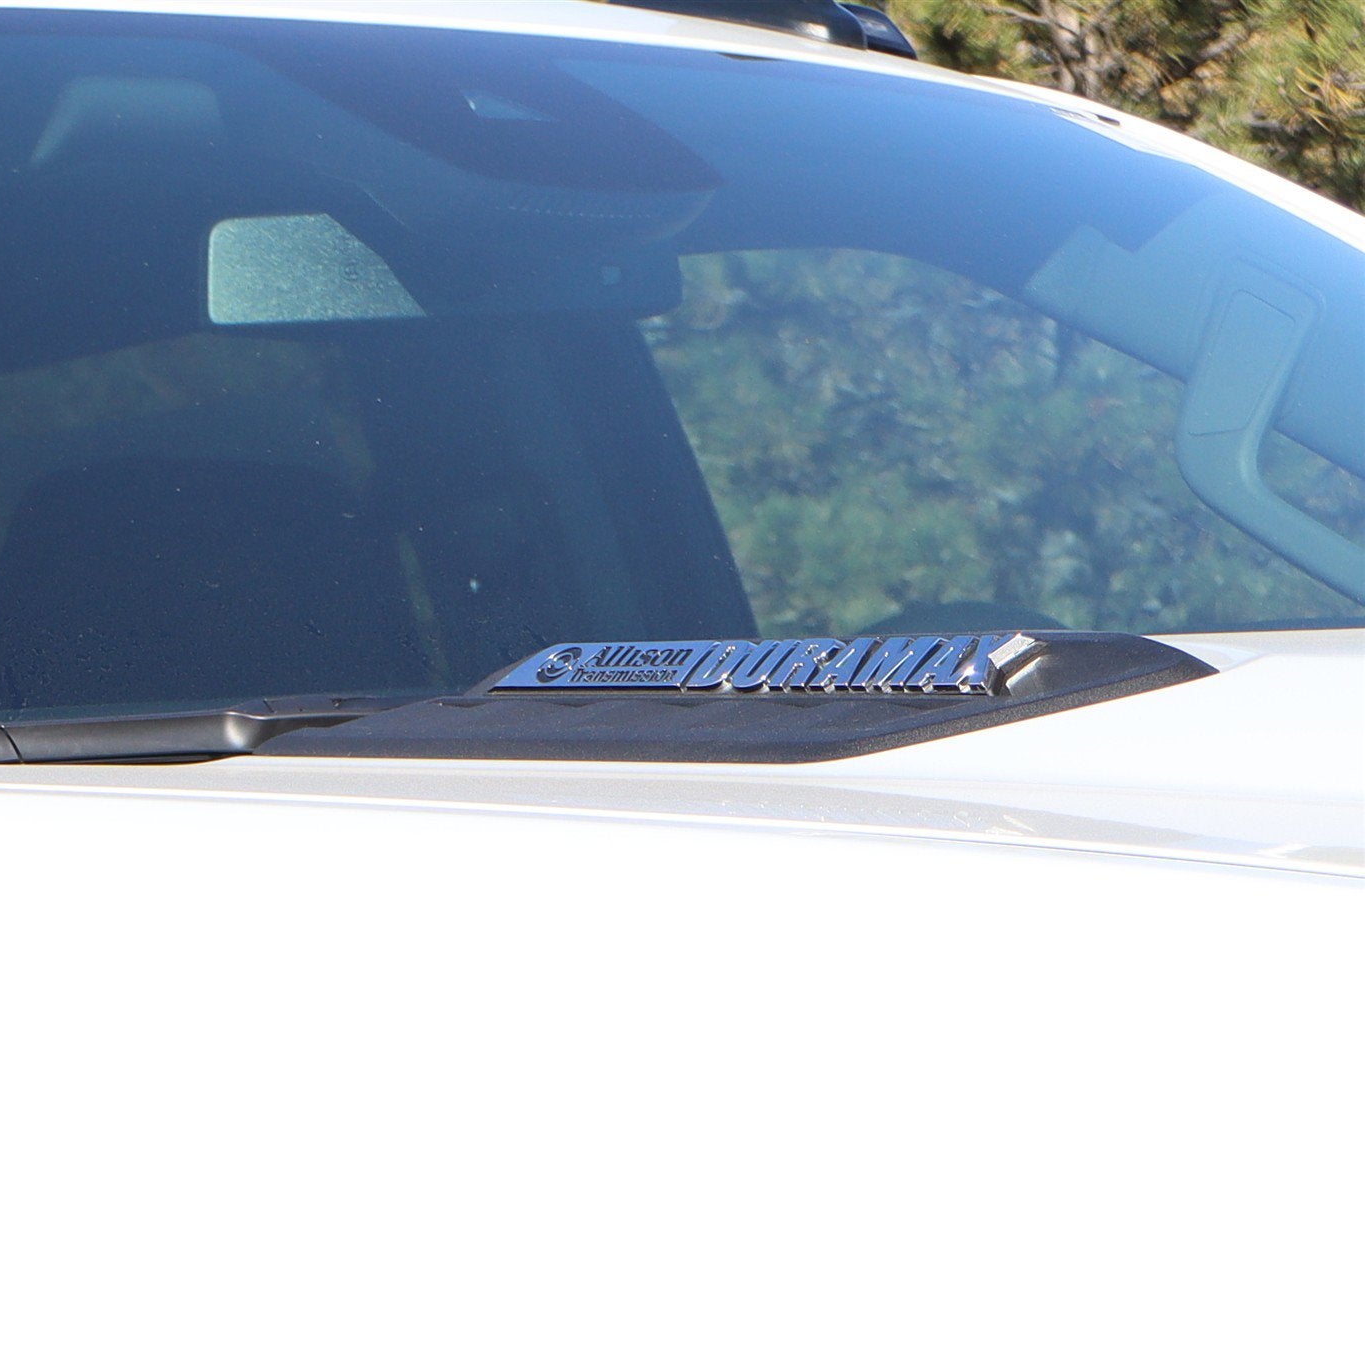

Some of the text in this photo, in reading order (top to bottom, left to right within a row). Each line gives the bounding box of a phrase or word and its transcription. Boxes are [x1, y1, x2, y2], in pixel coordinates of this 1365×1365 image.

[583, 645, 694, 668] Allison
[679, 633, 1037, 694] DURAMAX
[569, 667, 678, 684] Transmission
